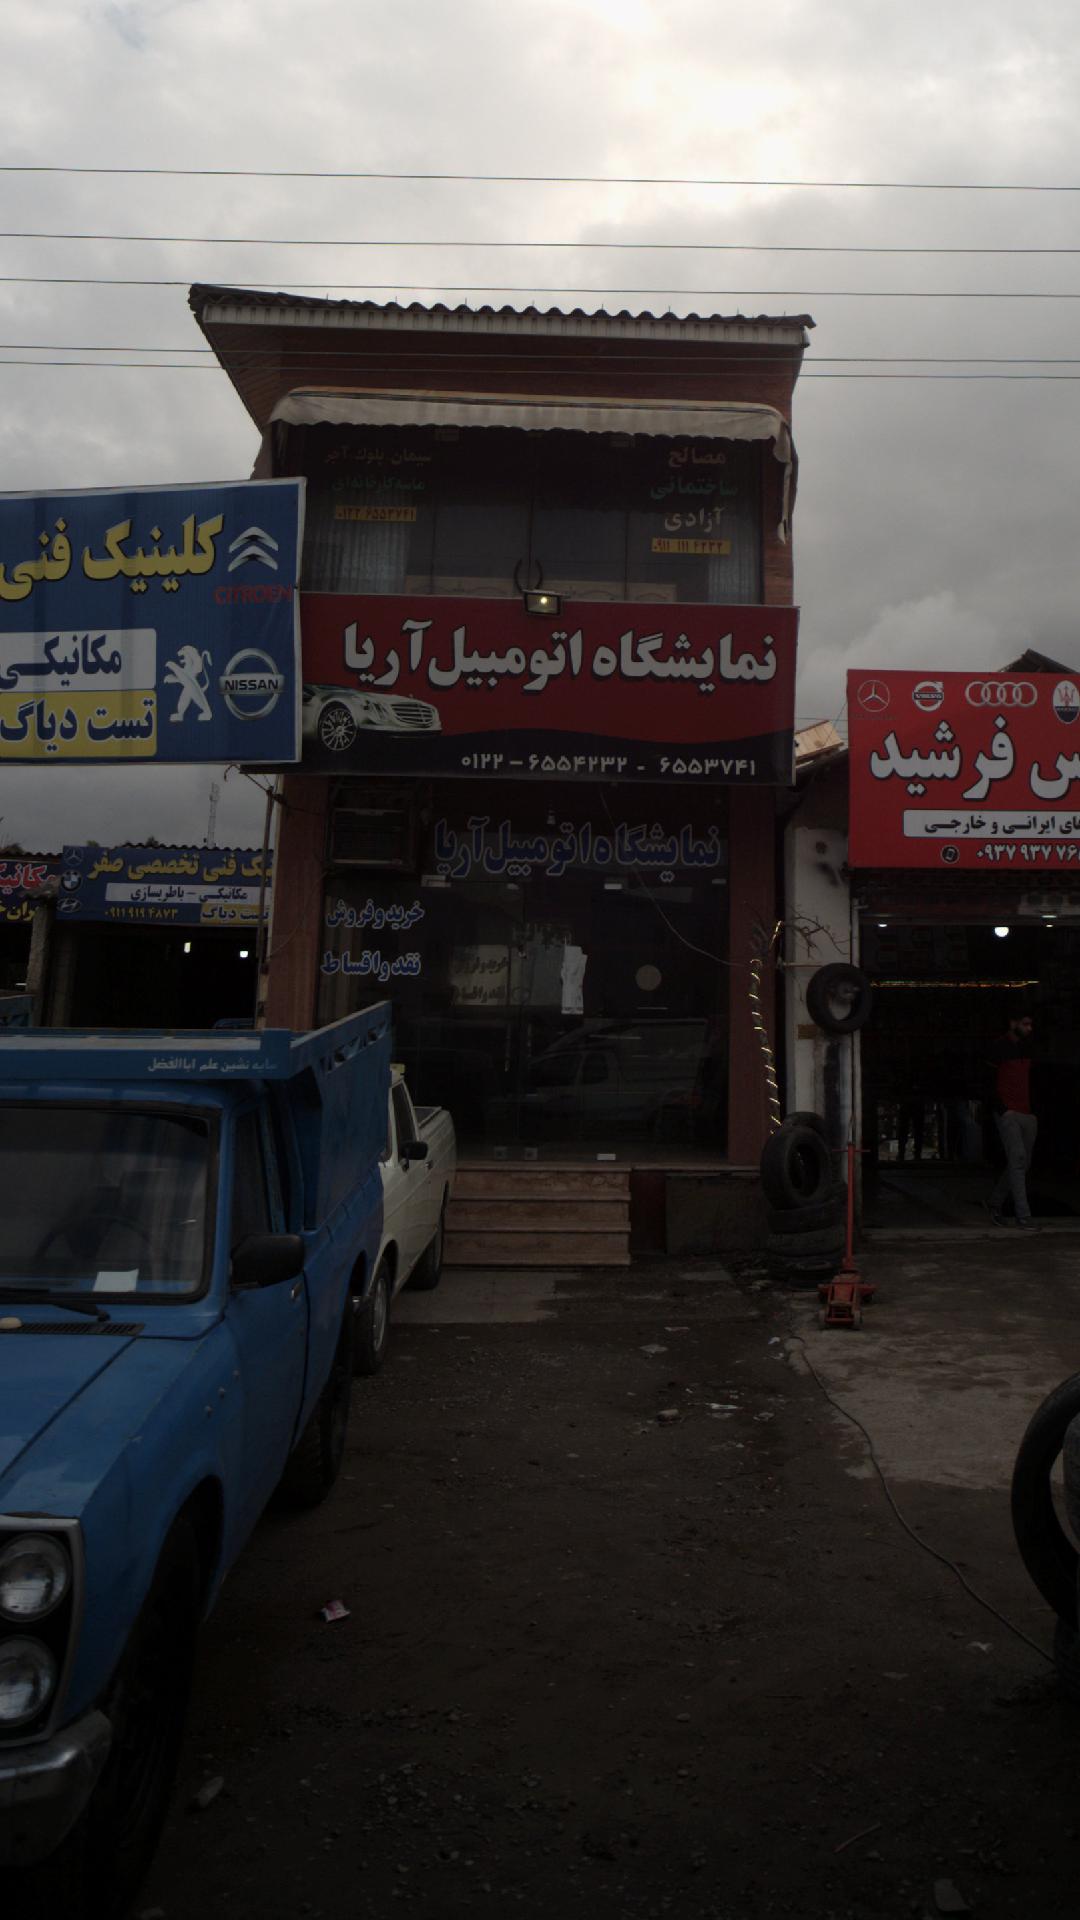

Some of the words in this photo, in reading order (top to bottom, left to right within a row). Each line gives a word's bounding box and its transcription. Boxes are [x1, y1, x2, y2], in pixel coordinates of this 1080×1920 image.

[668, 446, 727, 468] مصالح
[650, 476, 738, 500] ساختمانی
[664, 505, 726, 533] آزادی
[0, 517, 72, 602] فنی
[82, 513, 224, 592] کلینیک
[0, 633, 122, 690] مکانیکی
[344, 618, 433, 686] آریا
[428, 625, 583, 692] اتومبیل
[592, 630, 778, 693] نمایشگاه
[224, 679, 279, 691] NISSAN
[0, 699, 78, 751] دیاگ
[87, 699, 154, 741] تست
[461, 753, 504, 769] ۰۱۲۲
[528, 753, 628, 773] ۶۵۵۴۲۳۲
[659, 756, 756, 777] ۶۵۵۳۷۴۱
[869, 714, 1016, 801] فرشید
[924, 815, 986, 834] خارجی
[990, 821, 999, 834] و
[1002, 815, 1056, 834] ایرانی
[434, 815, 491, 878] آریا
[483, 819, 592, 876] اتومبیل
[592, 822, 721, 882] نمایشگاه
[127, 852, 200, 881] تخصصی
[203, 852, 236, 882] فنی
[200, 887, 249, 903] مکانیکی
[326, 898, 375, 928] فروش
[372, 907, 385, 930] و
[386, 900, 426, 930] خرید
[320, 950, 381, 975] اقساط
[378, 960, 391, 982] و
[391, 952, 422, 976] نقد
